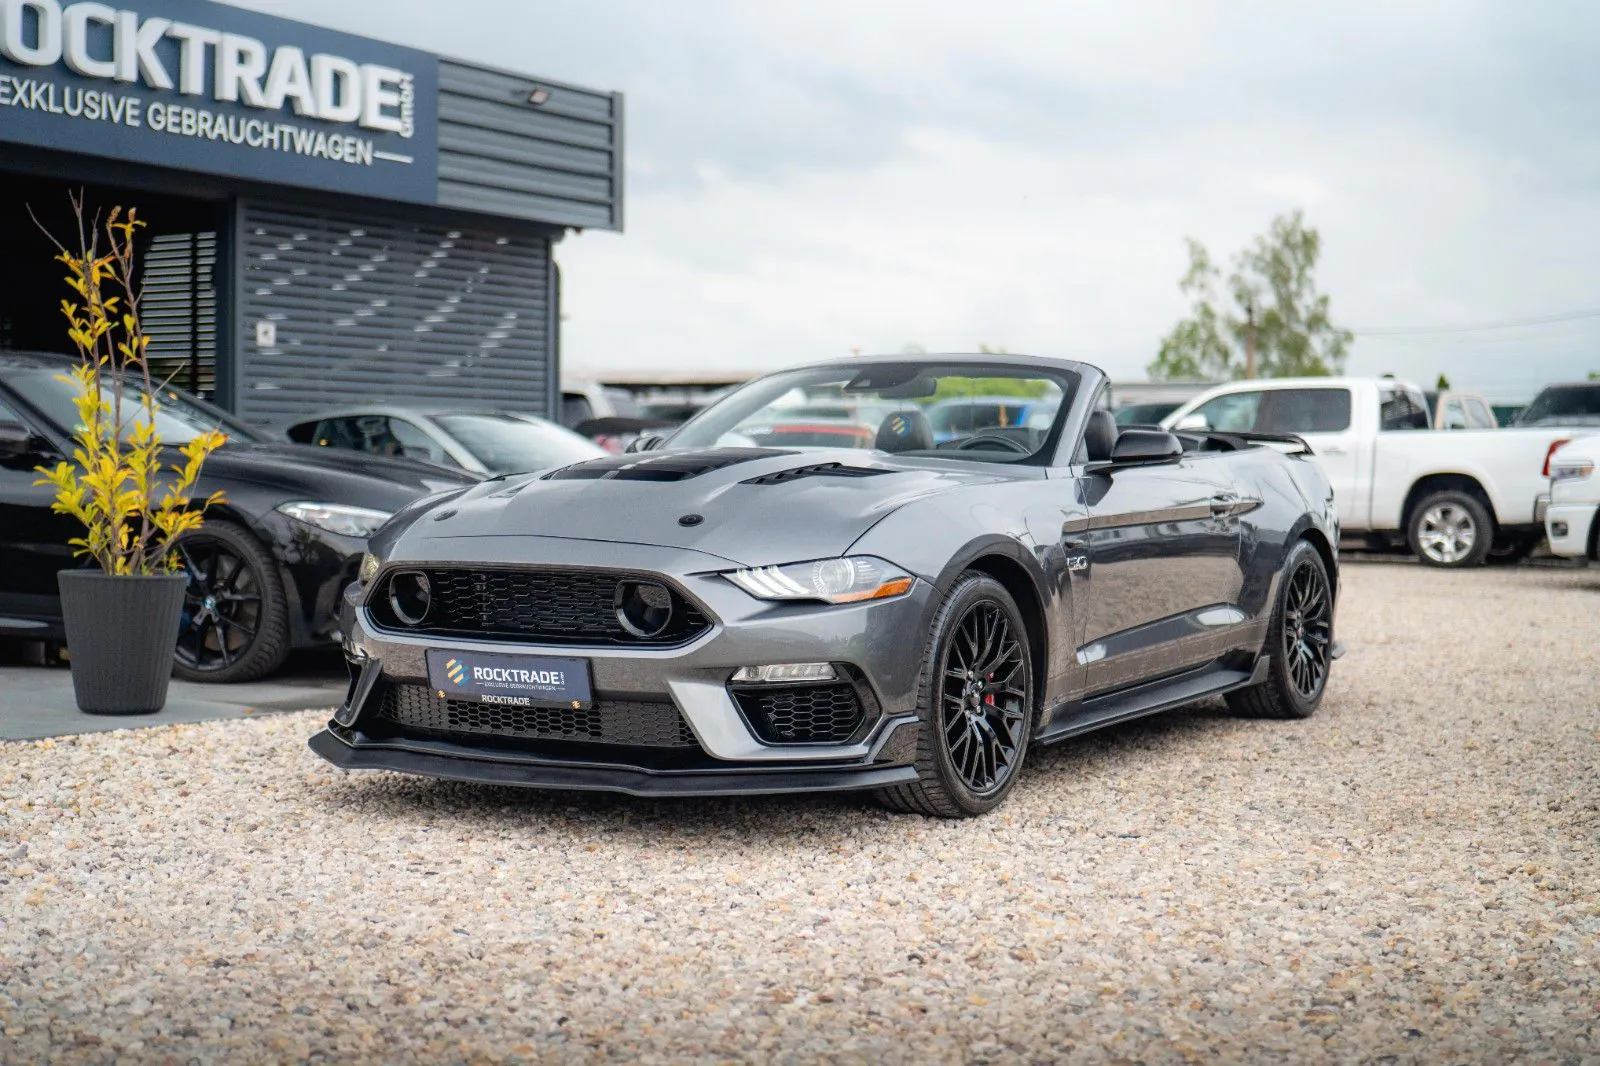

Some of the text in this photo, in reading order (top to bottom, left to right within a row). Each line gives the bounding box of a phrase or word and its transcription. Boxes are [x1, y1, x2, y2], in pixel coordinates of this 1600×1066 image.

[0, 74, 373, 167] EXKLUSIVE GEBRAUCHTWAGEN
[473, 667, 560, 685] ROCKTRADE
[481, 694, 530, 705] ROCKTRADE
